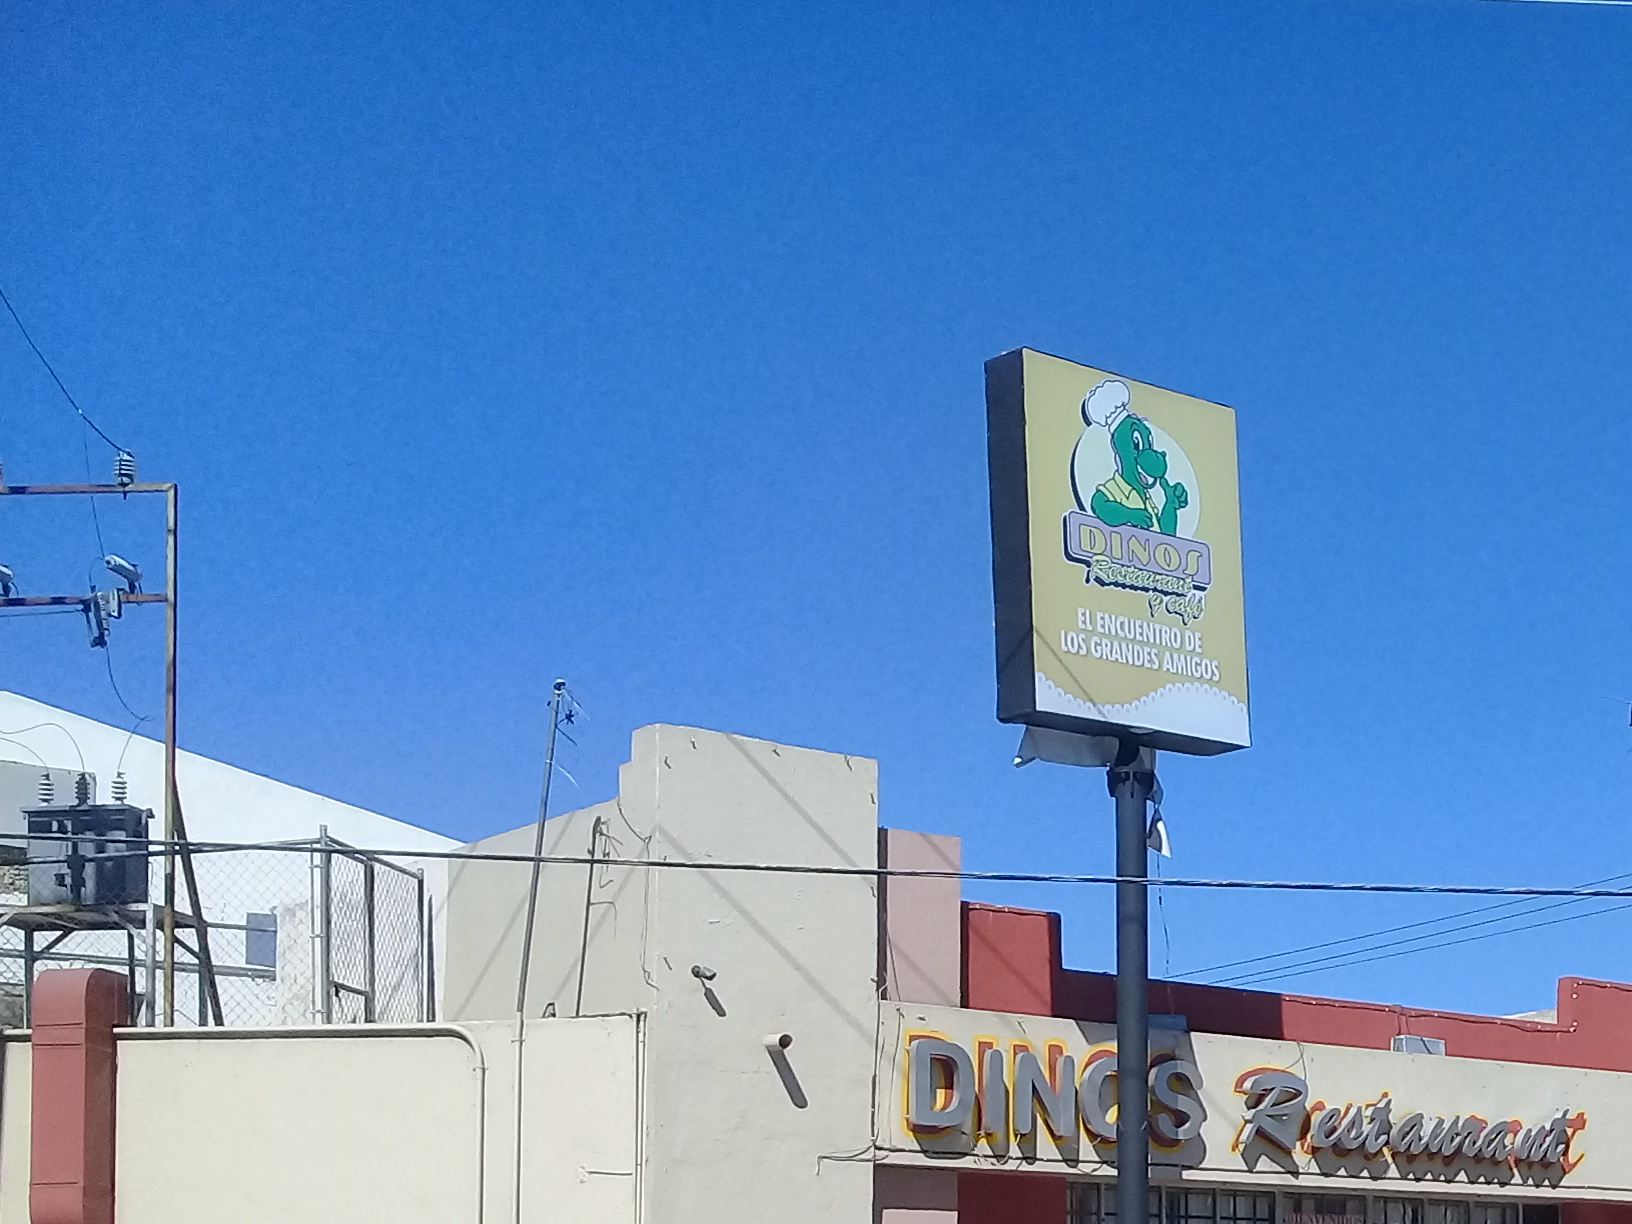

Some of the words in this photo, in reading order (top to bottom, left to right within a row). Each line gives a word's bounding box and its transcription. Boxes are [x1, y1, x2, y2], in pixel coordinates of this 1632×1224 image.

[1078, 523, 1202, 576] DINOS
[1090, 554, 1193, 592] Restaurant
[1060, 629, 1087, 656] LOS
[1090, 636, 1160, 670] GRANDES
[1163, 650, 1221, 682] AMIGOS
[1077, 607, 1093, 631] EL
[1096, 611, 1182, 649] ENCUENTRO
[1185, 629, 1203, 653] DE
[1239, 1069, 1577, 1164] Restaurant
